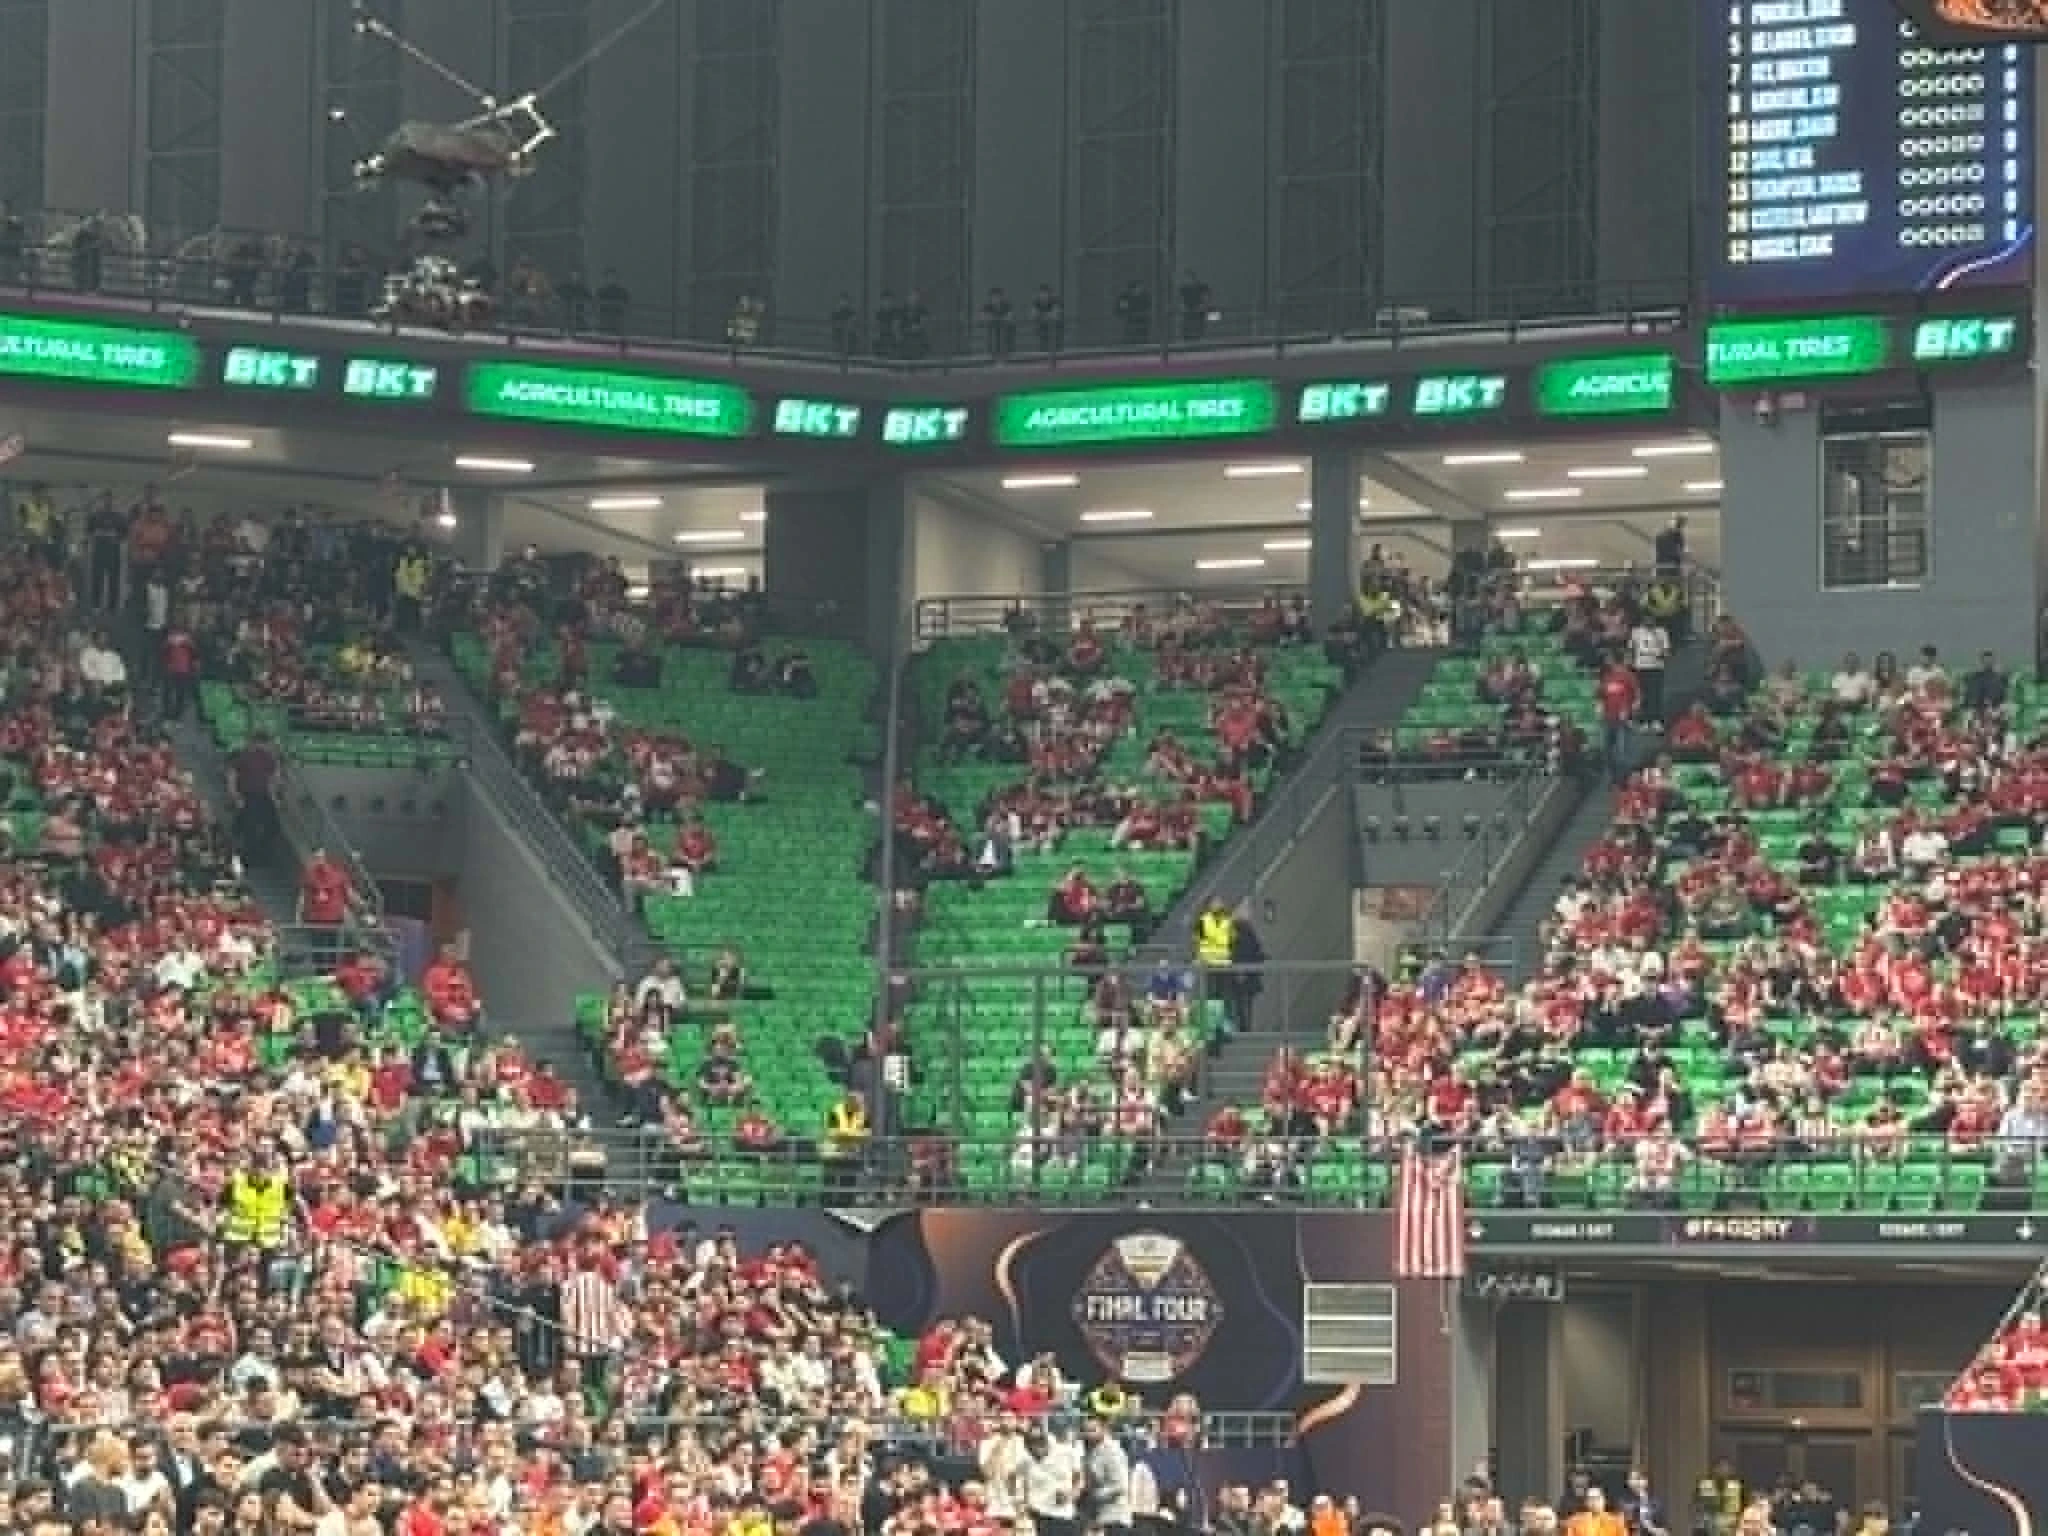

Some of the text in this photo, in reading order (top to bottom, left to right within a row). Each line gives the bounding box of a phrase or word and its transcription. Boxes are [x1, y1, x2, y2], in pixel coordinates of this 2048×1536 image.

[102, 343, 167, 369] TIRES
[1785, 334, 1852, 360] TIRES
[1913, 320, 2016, 359] BKT
[223, 347, 319, 386] BKT
[343, 359, 436, 396] BKT
[498, 379, 721, 418] AGRICULTURAL TIRES
[1297, 383, 1389, 424] BKT
[1413, 375, 1505, 414] BKT
[774, 398, 860, 436] BKT
[883, 408, 969, 444] BKT
[1024, 397, 1246, 430] AGRICULTURAL TIRES
[1087, 1295, 1208, 1321] FINAL FOUR
